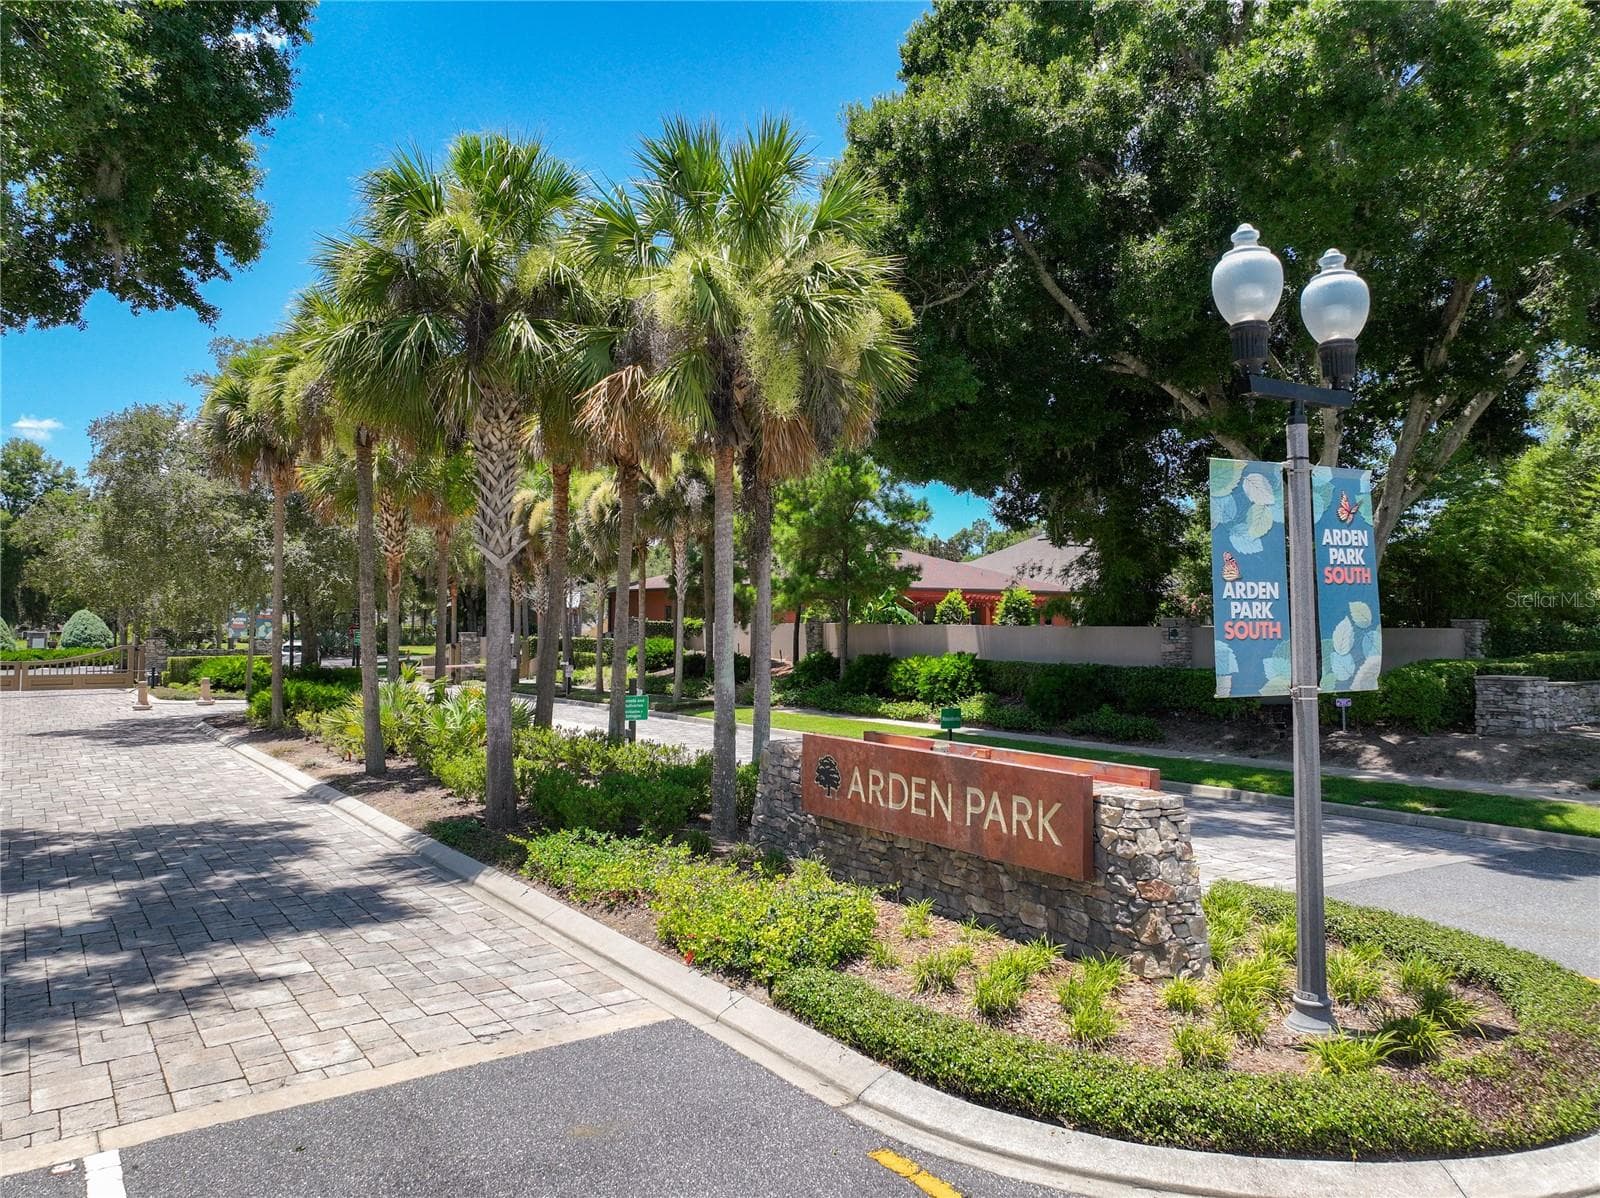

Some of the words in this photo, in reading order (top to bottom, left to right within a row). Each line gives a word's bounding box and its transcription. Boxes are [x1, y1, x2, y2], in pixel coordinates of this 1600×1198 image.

[1322, 528, 1369, 546] ARDEN
[1329, 548, 1366, 565] PARK
[1324, 567, 1372, 584] SOUTH
[1222, 581, 1279, 599] ARDEN
[1230, 601, 1274, 619] PARK
[1224, 621, 1282, 640] SOUTH
[847, 766, 952, 822] ARDEN
[965, 787, 1063, 847] PARK
